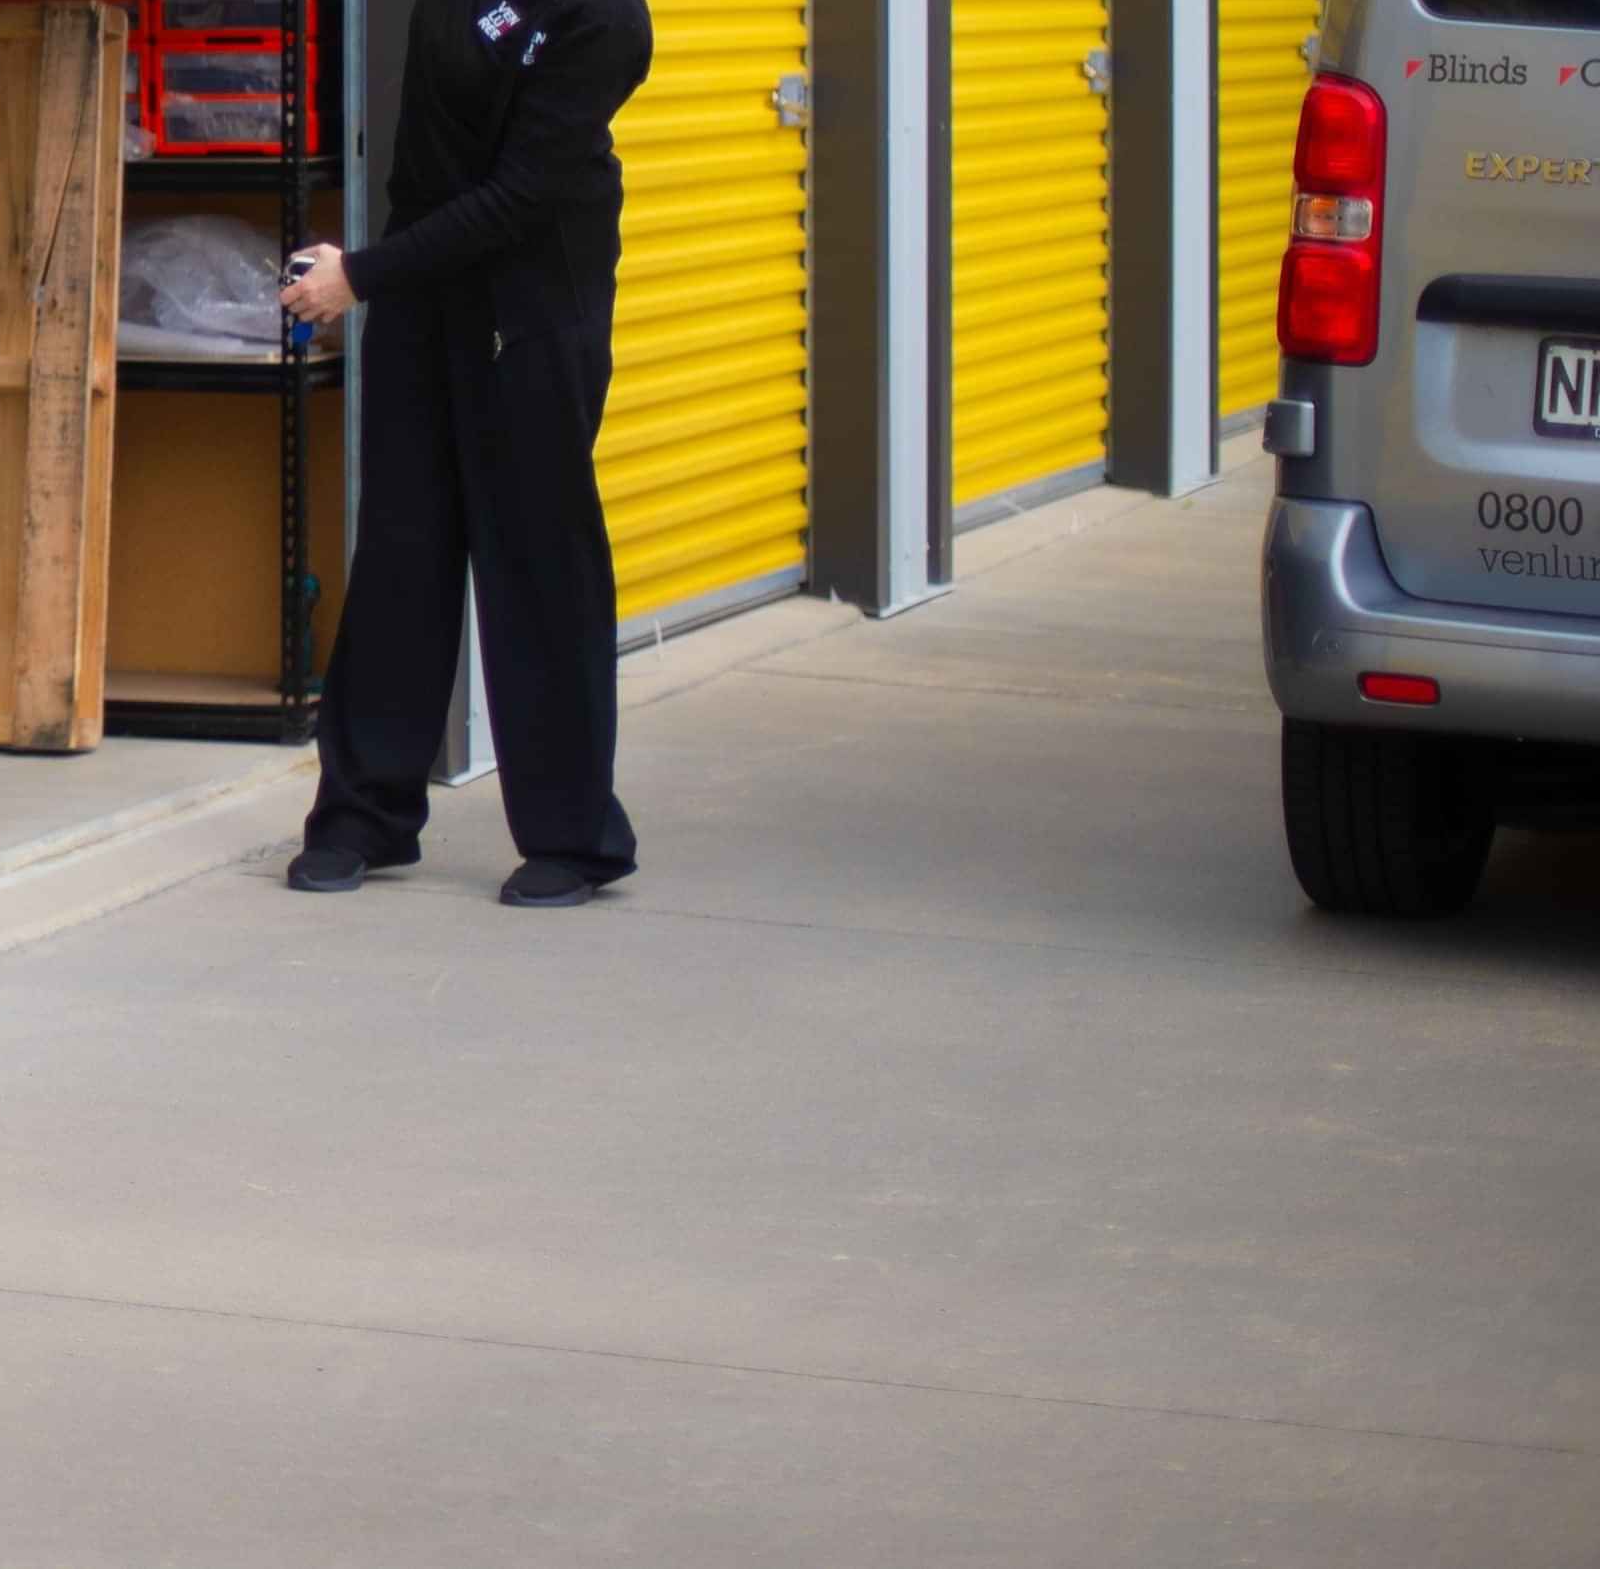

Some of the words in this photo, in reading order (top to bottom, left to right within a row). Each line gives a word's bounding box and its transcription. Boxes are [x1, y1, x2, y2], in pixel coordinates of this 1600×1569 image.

[1427, 53, 1527, 86] Blinds
[1548, 356, 1600, 417] N
[1478, 491, 1584, 536] 0800
